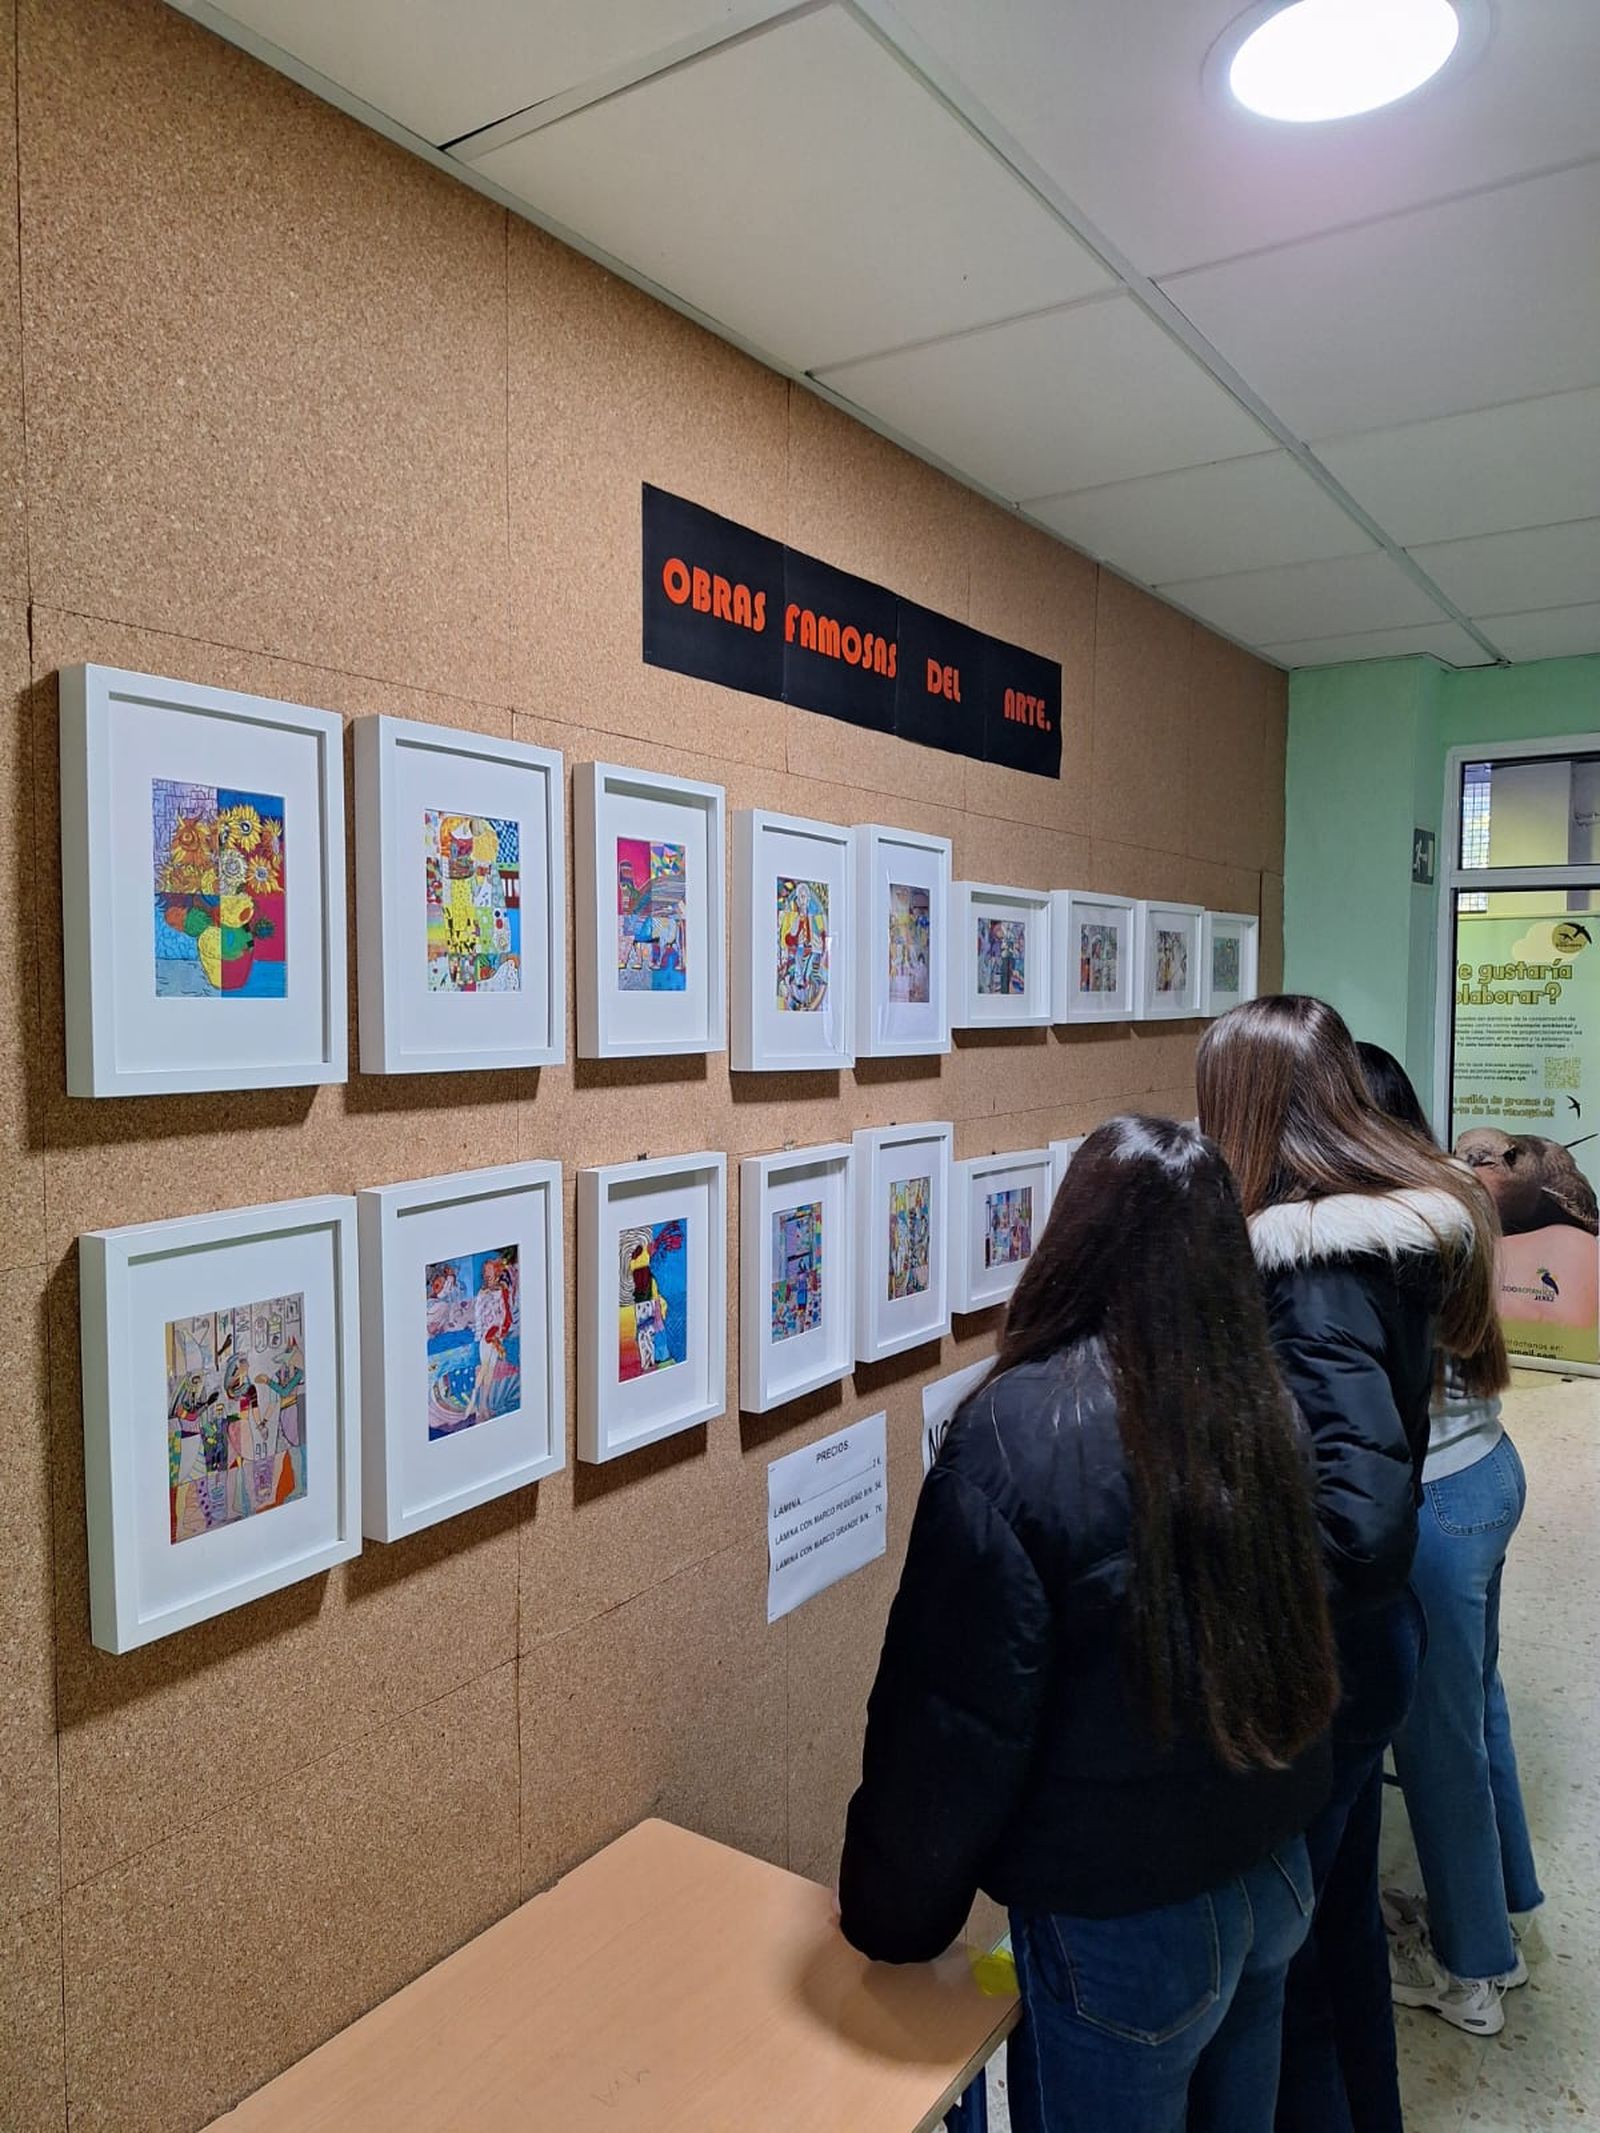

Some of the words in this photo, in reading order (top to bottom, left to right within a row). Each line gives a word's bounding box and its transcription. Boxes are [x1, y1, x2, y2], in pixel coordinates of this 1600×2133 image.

[662, 557, 767, 632] OBRAS
[784, 602, 897, 679] FAMOSAS
[926, 657, 961, 703] DEL
[1003, 687, 1052, 732] ARTE.
[1457, 962, 1473, 980] e
[1478, 958, 1573, 985] gustaría
[816, 1440, 849, 1463] PRECIOS
